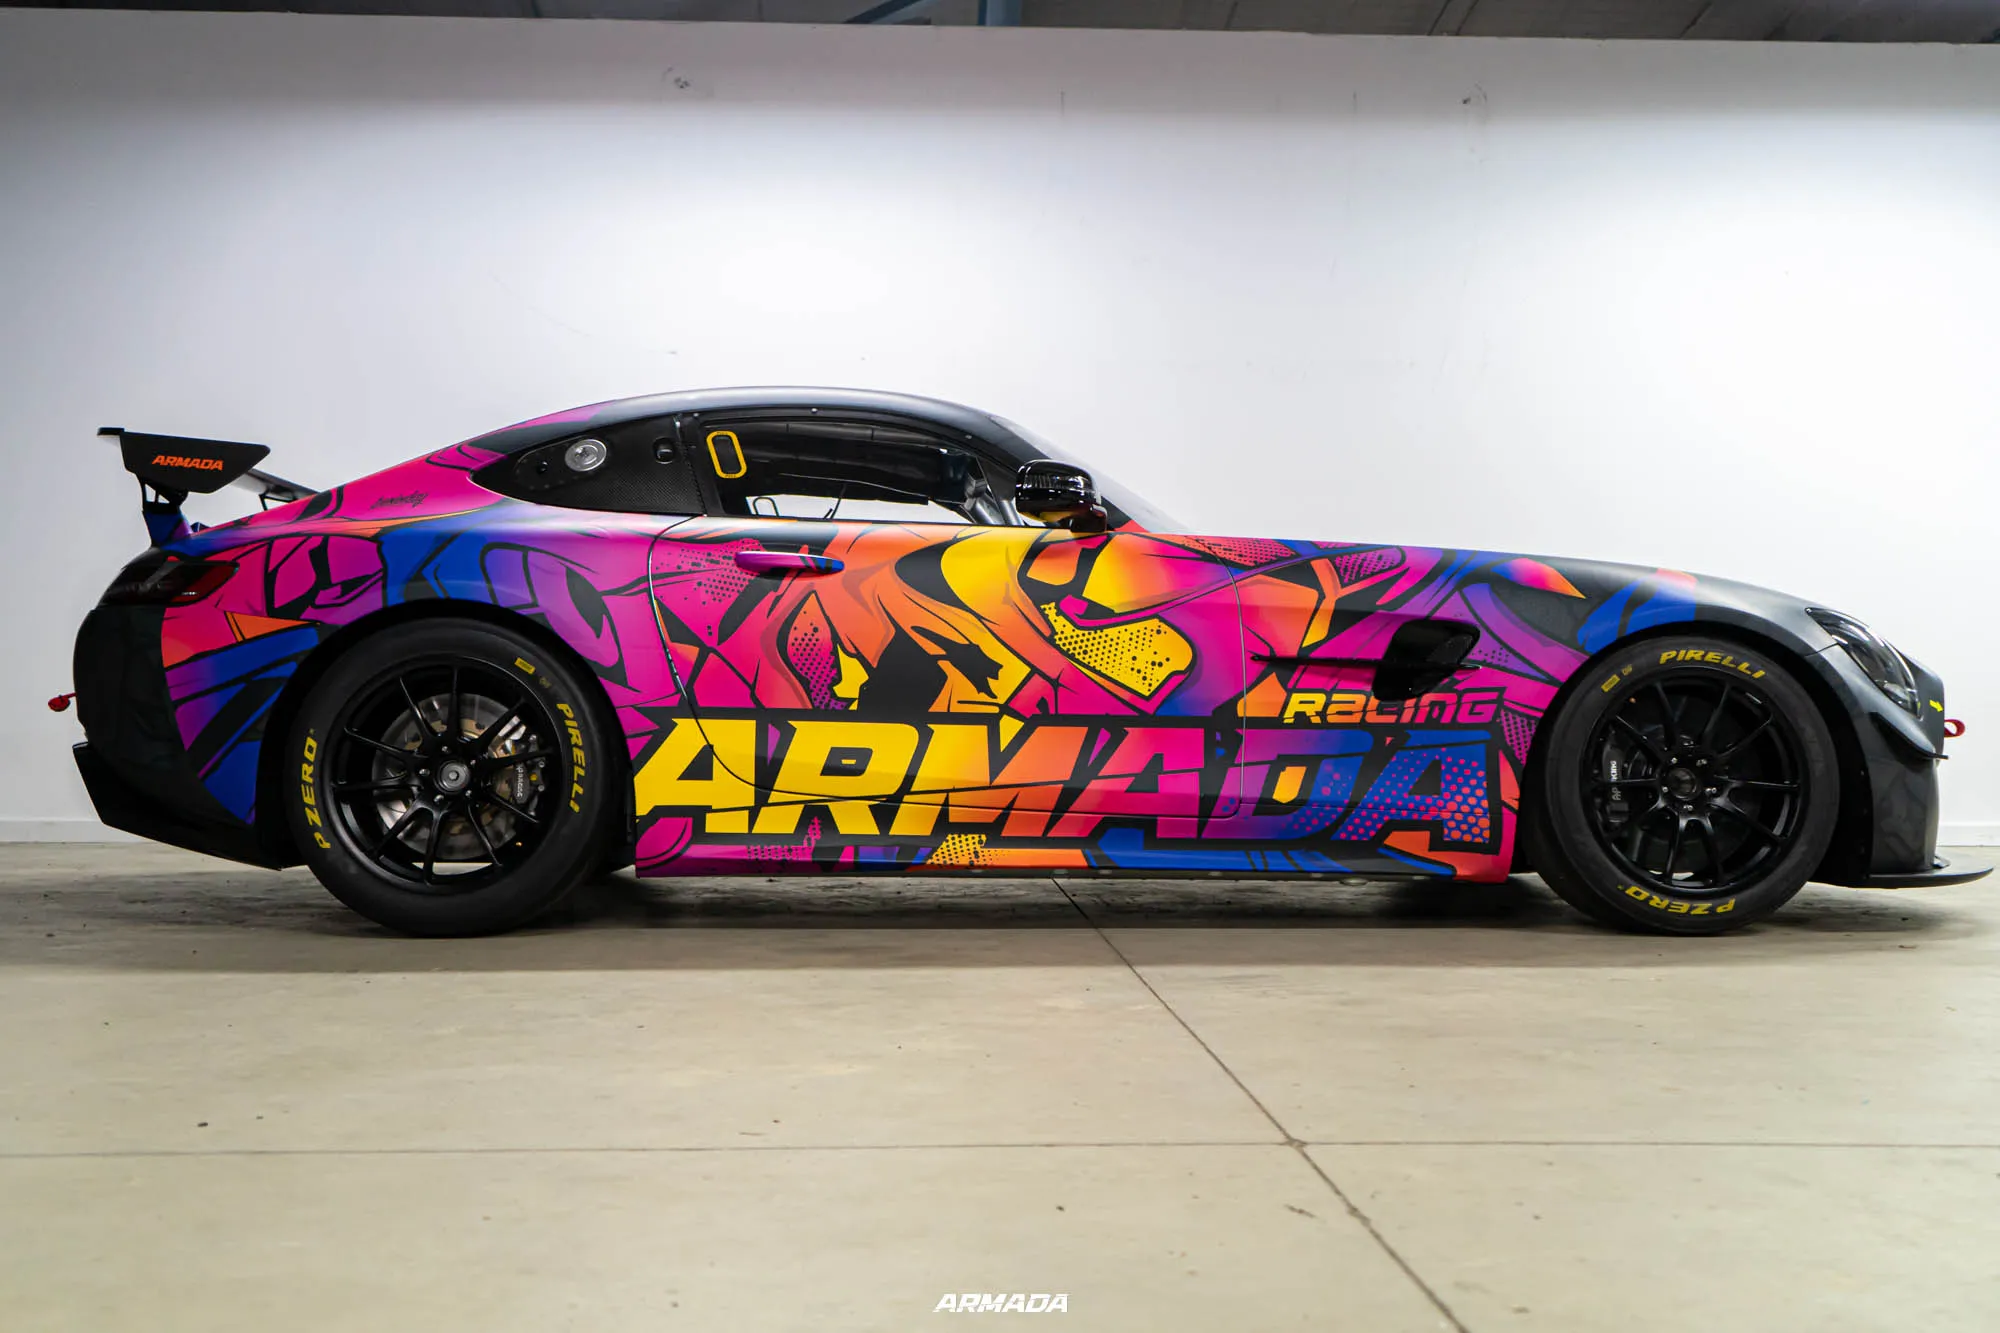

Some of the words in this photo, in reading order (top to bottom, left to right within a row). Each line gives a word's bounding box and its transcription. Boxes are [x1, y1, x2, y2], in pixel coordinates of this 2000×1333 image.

[152, 455, 223, 471] ARMADA
[1660, 649, 1765, 679] PIRELLI
[301, 736, 322, 827] ZERO
[556, 703, 585, 813] PIRELLI
[634, 717, 1491, 843] ARMADA
[1625, 886, 1713, 915] ZERO
